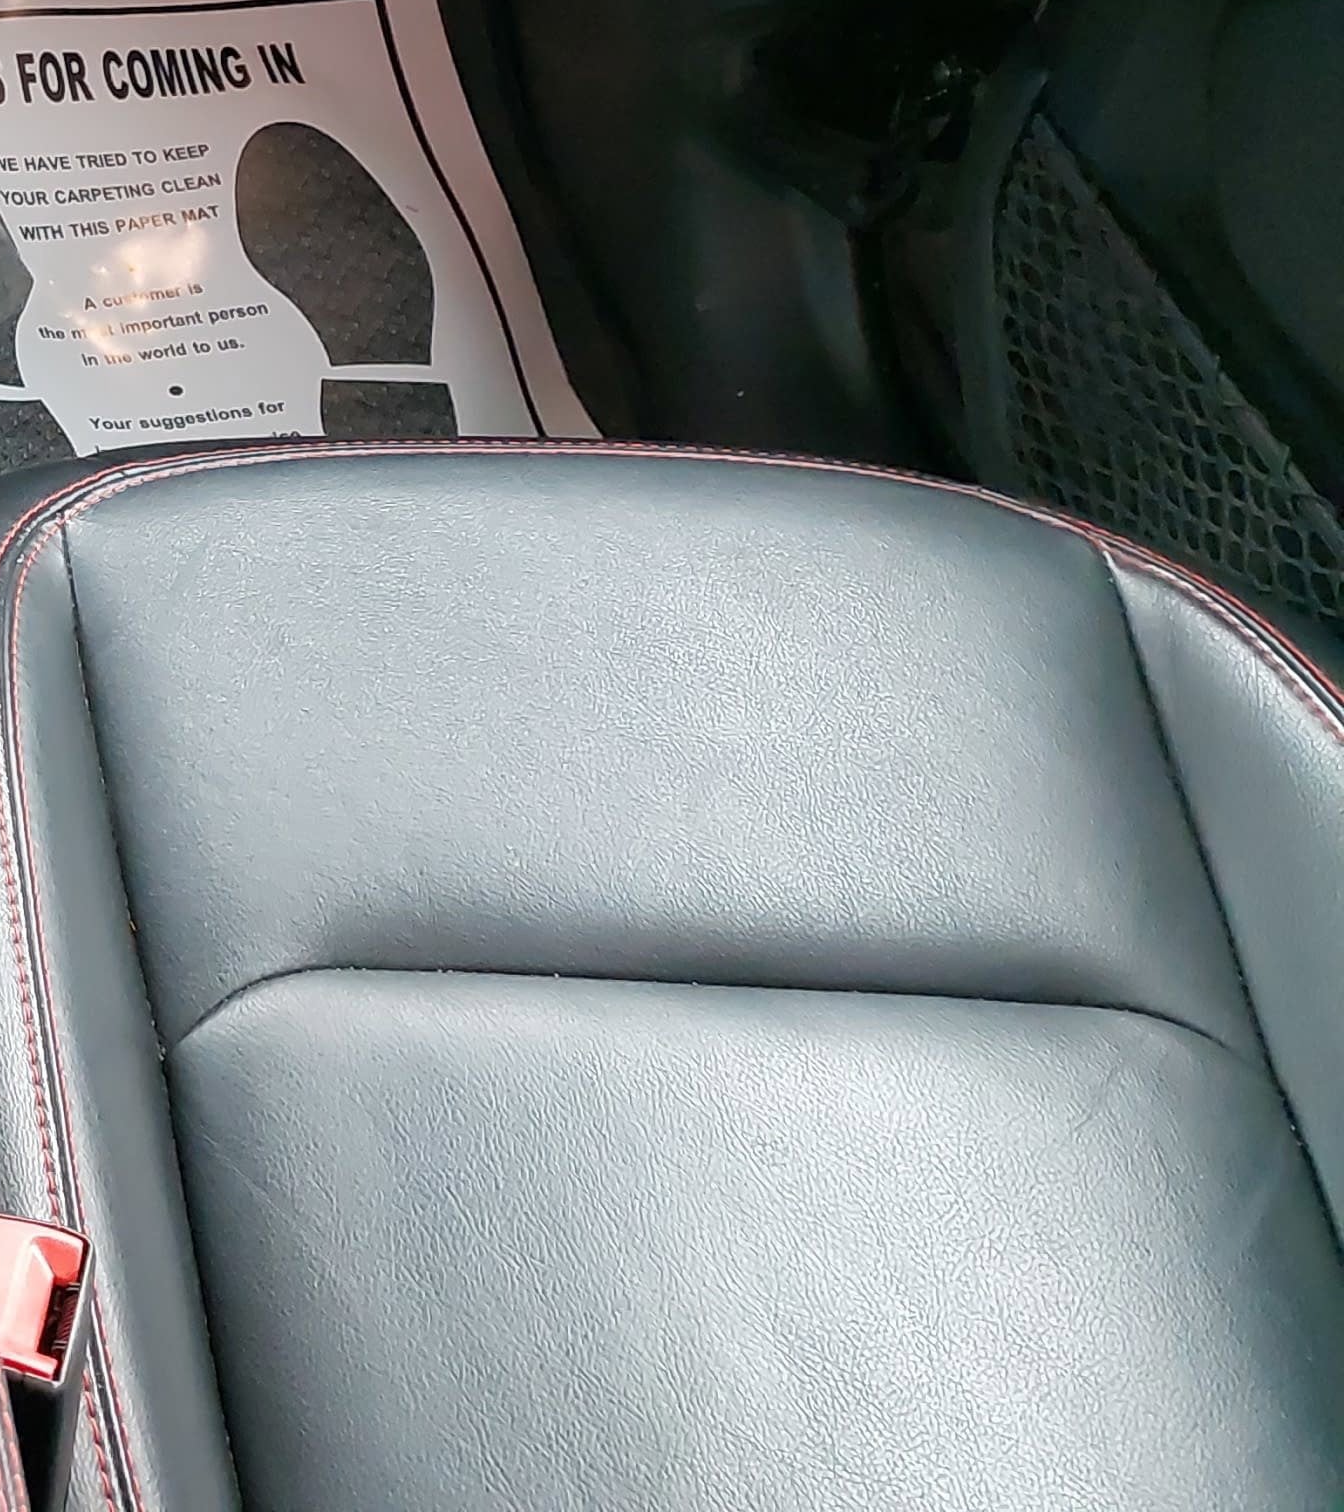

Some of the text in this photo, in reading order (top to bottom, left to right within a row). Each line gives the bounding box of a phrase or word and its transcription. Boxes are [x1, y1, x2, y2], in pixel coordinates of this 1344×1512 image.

[15, 42, 306, 104] FOR COMING IN
[23, 156, 72, 172] HAVE
[75, 152, 128, 169] TRIED
[131, 150, 157, 165] TO
[163, 143, 210, 162] KEEP
[0, 173, 222, 206] YOUR CARPETING CLEAN
[18, 205, 220, 241] WITH THIS PAPER MAT
[84, 282, 204, 311] A is
[38, 303, 269, 340] the important person
[104, 351, 133, 365] the
[137, 343, 187, 361] world
[192, 341, 211, 355] to
[217, 336, 245, 351] us.
[88, 401, 286, 431] Your suggestions for
